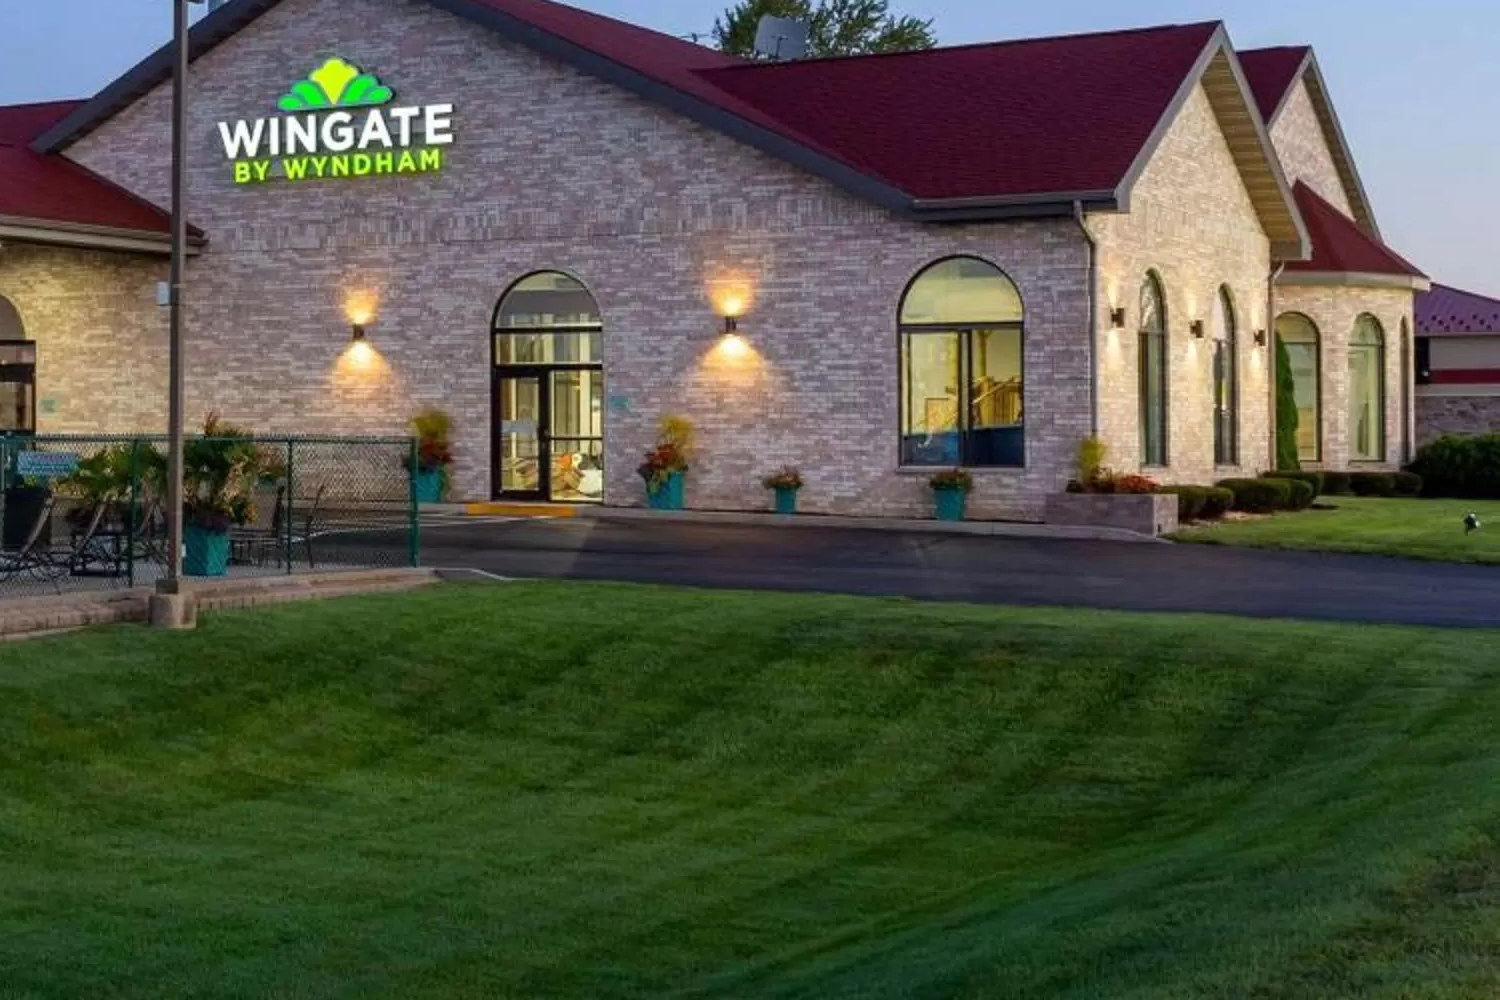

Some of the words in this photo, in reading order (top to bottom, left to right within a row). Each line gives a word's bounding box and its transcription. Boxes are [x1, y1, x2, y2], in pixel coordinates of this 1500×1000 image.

[217, 104, 454, 159] WINGATE
[235, 161, 269, 183] BY
[284, 149, 440, 180] WYNDHAM
